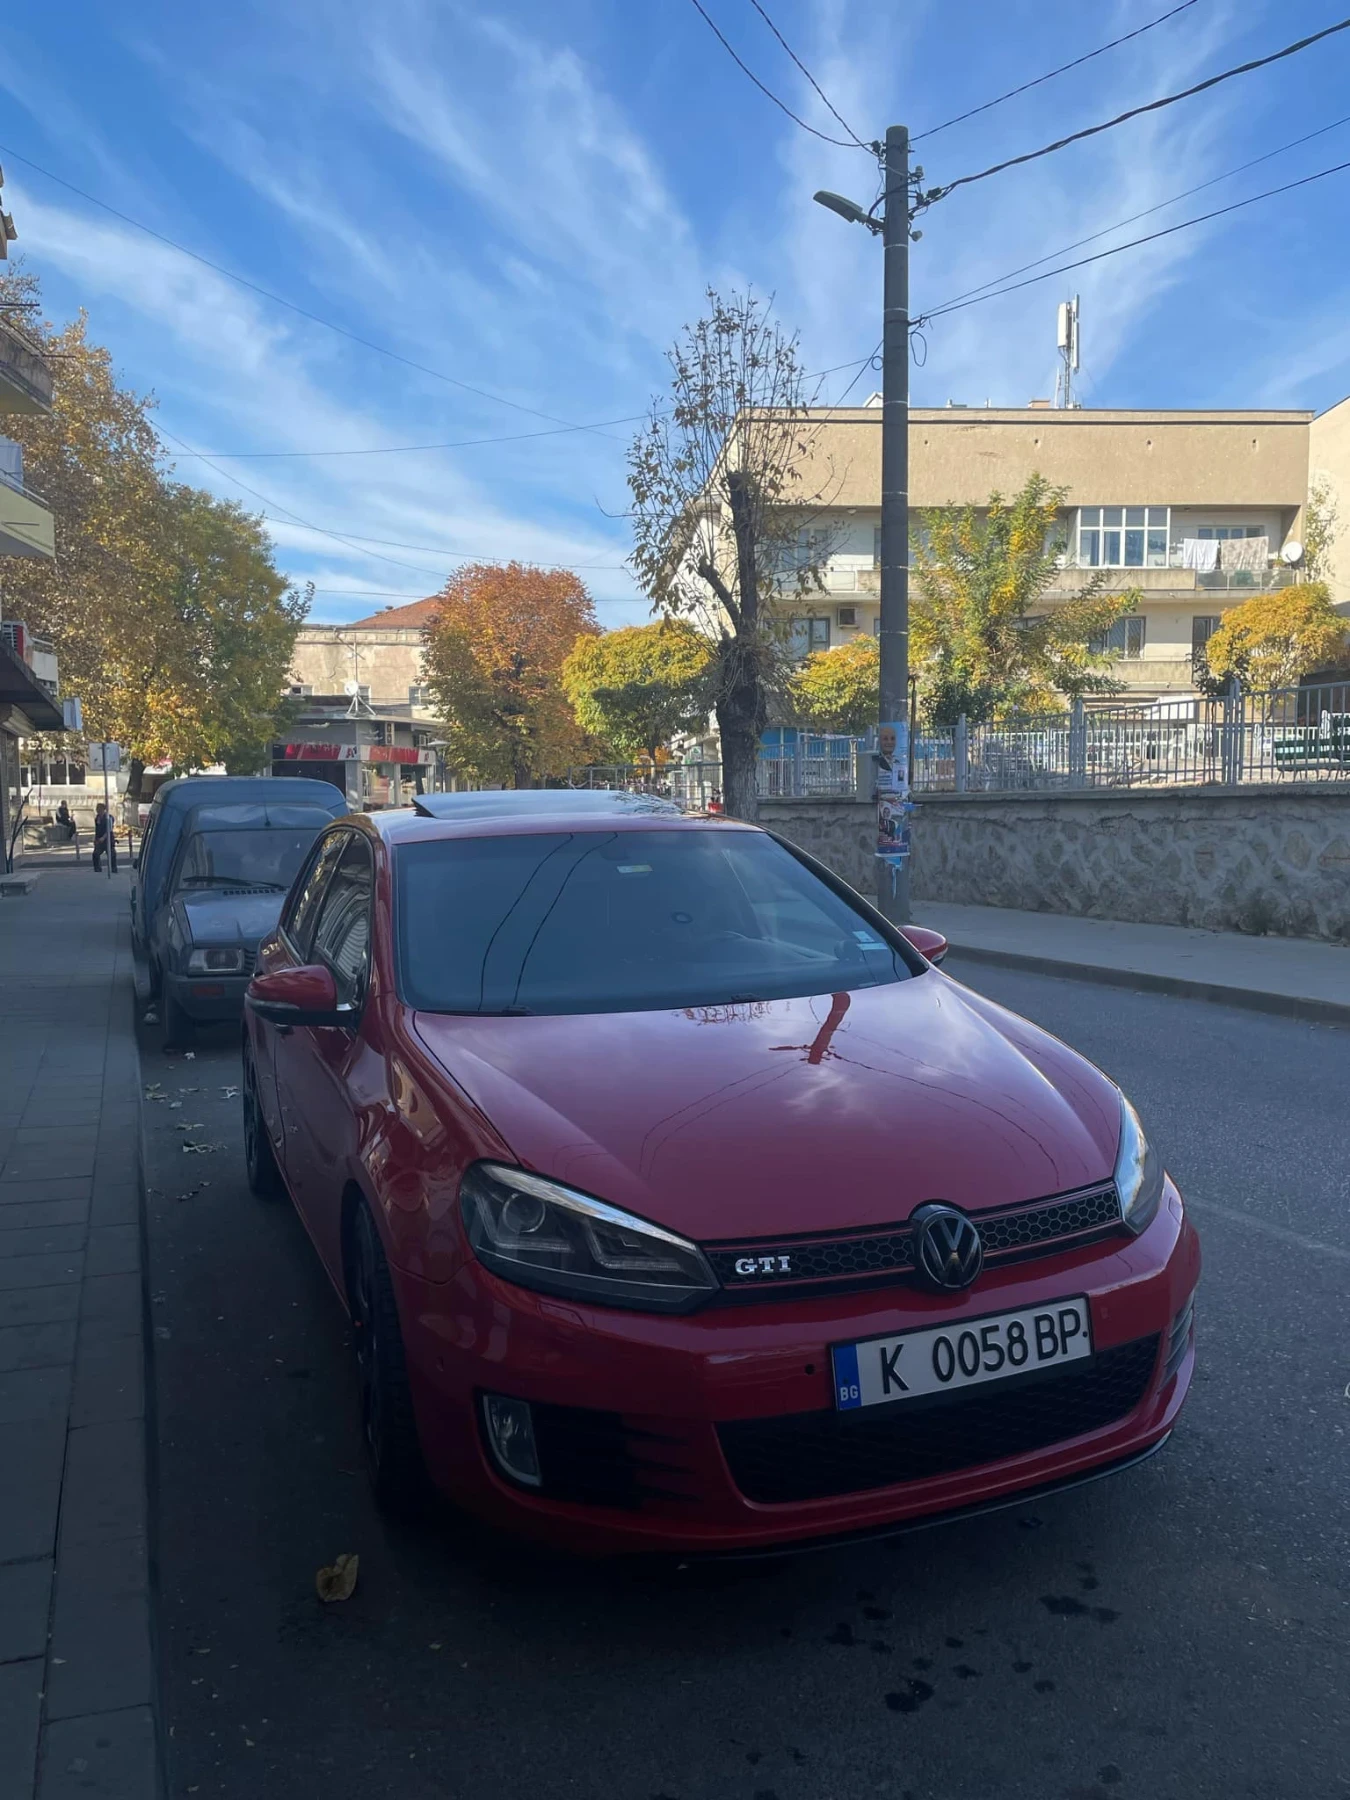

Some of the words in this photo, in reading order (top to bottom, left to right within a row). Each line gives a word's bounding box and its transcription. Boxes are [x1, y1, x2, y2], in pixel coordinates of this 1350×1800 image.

[735, 1256, 791, 1275] GTI
[879, 1343, 909, 1394] K
[840, 1385, 858, 1401] BG
